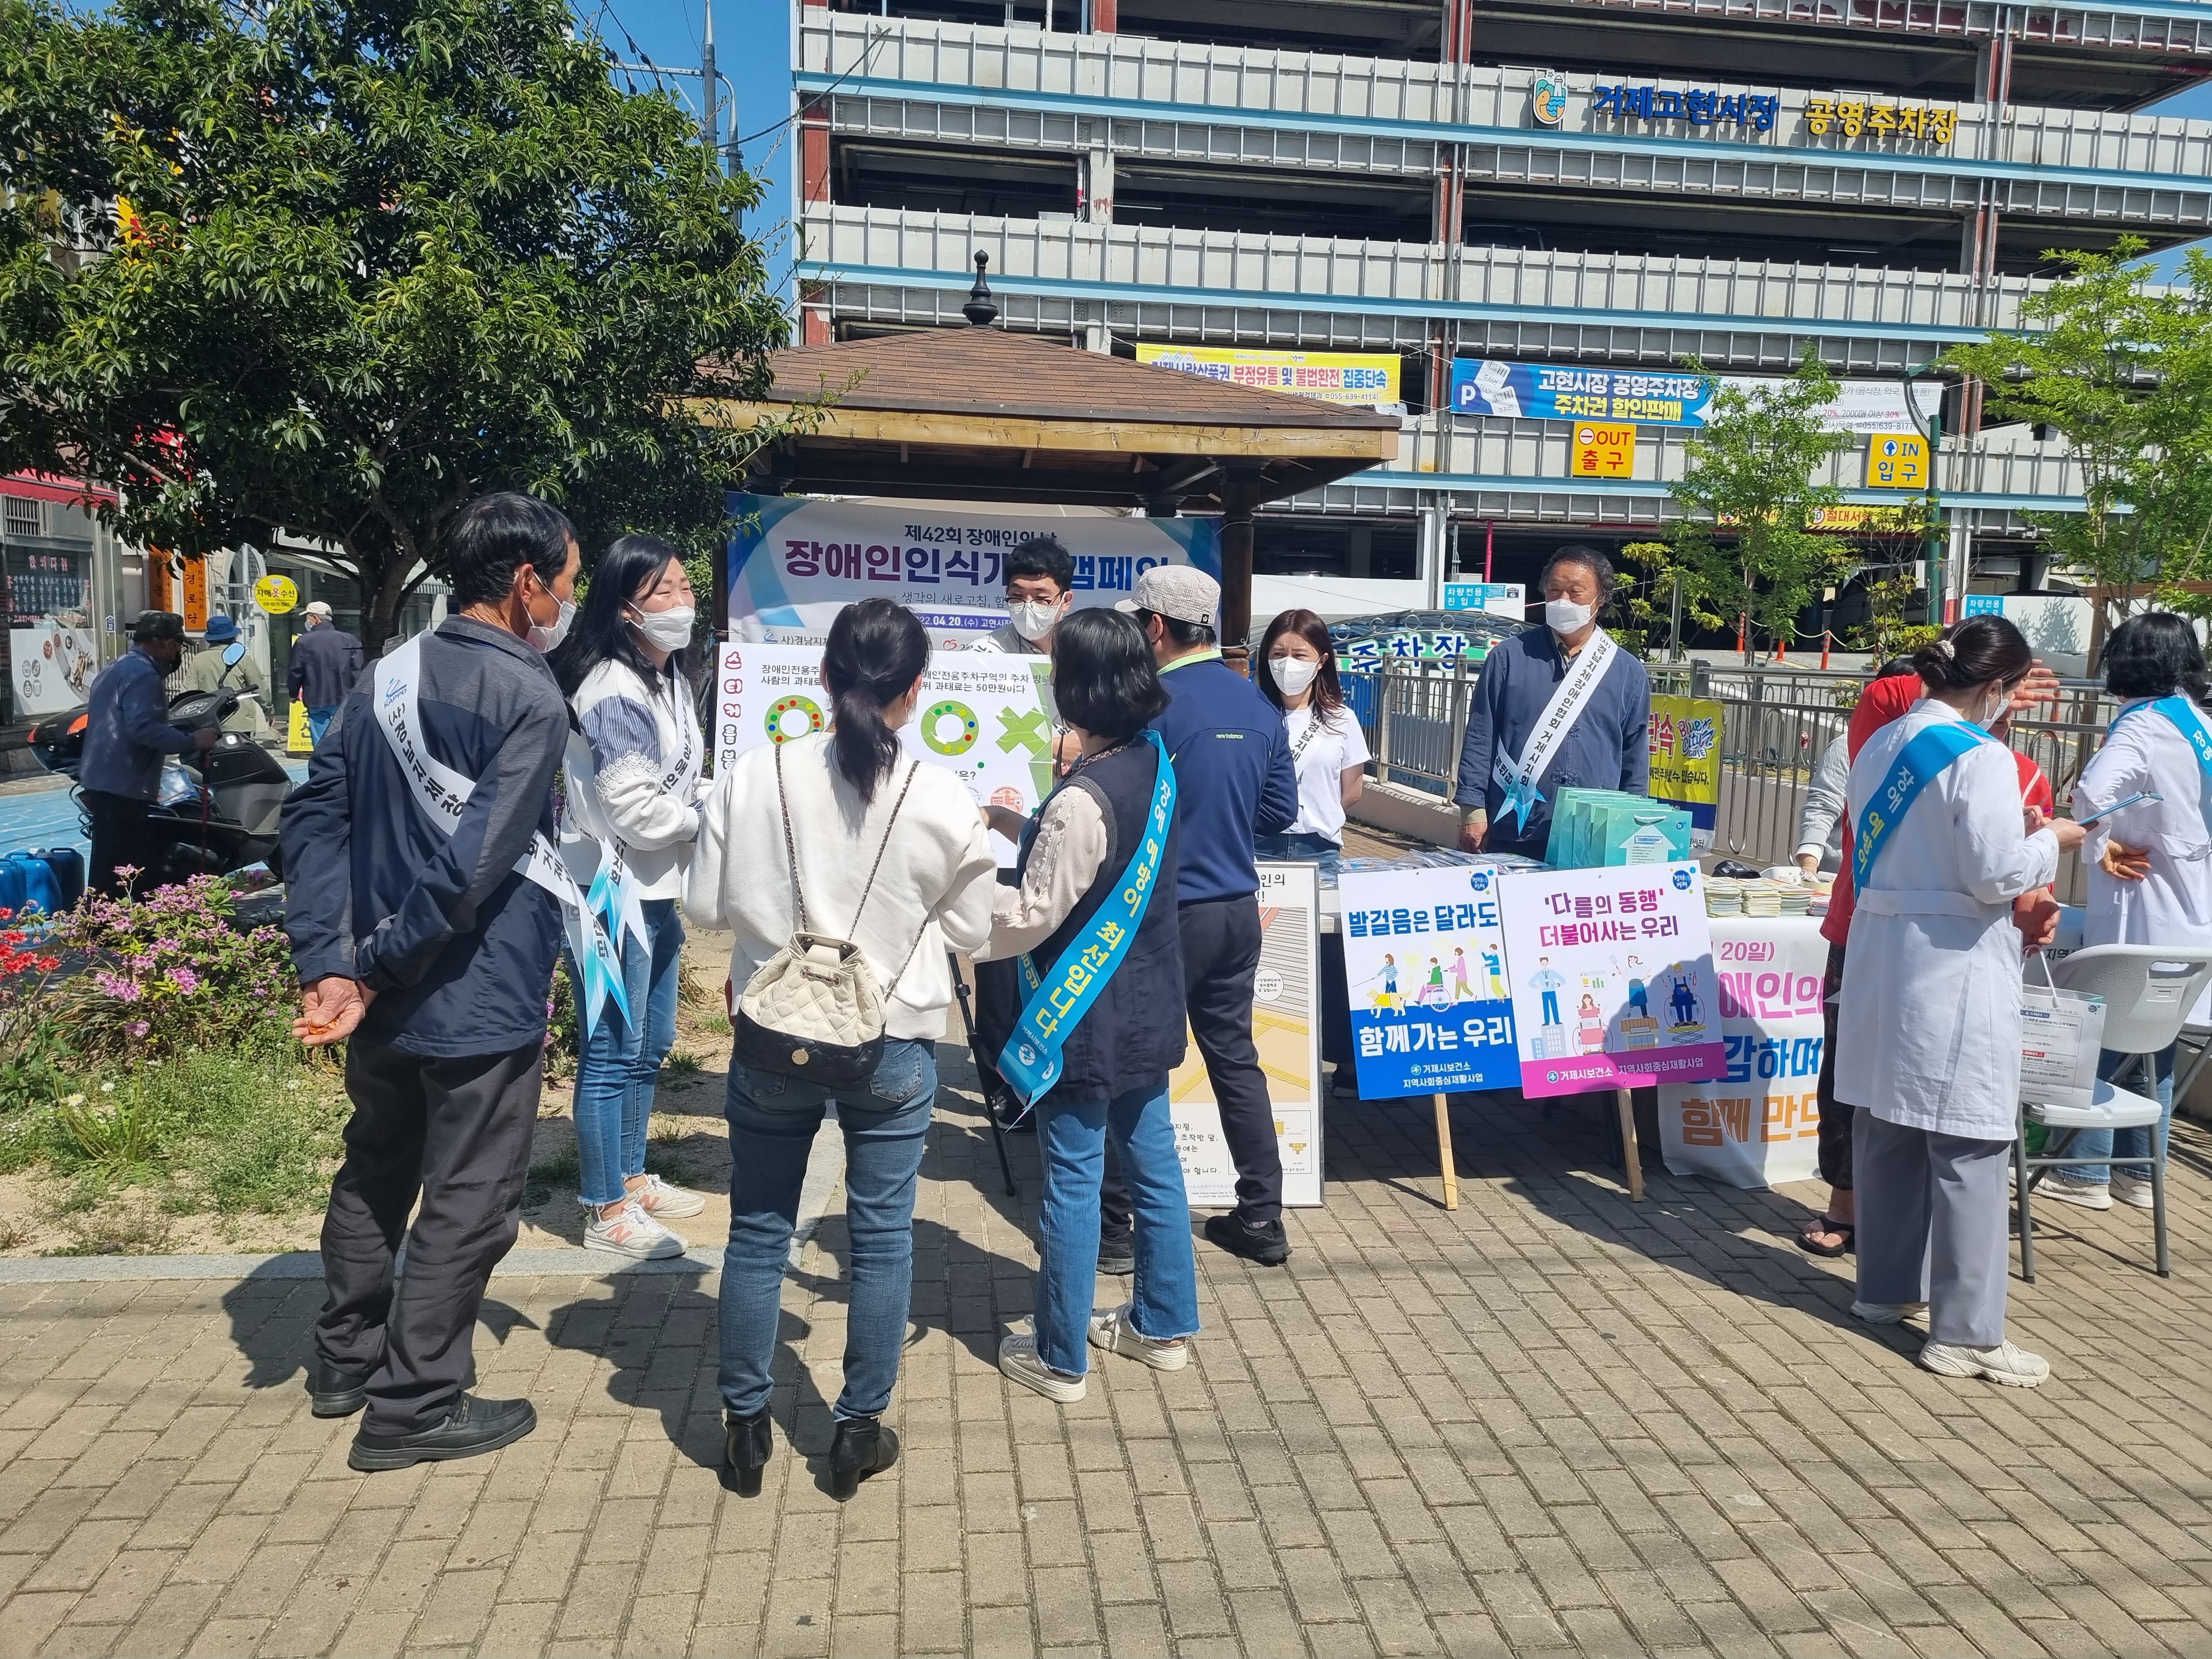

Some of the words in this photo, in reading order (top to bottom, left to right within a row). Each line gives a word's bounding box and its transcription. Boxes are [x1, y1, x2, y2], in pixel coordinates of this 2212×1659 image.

[1594, 86, 1780, 132] 거제고현시장
[1805, 99, 1959, 144] 공영주차장
[1234, 365, 1278, 385] 부정유통
[1282, 367, 1293, 386] 및
[1296, 368, 1340, 388] 불법환전
[1343, 369, 1386, 389] 집중단속
[1538, 370, 1610, 394] 고현시장
[1613, 375, 1700, 400] 공영주차장
[1461, 385, 1476, 405] P
[1884, 387, 1900, 396] 약국,
[1554, 394, 1607, 417] 주차권
[1612, 397, 1683, 421] 할인판매
[1842, 410, 1866, 418] 2000매
[1868, 410, 1884, 419] 이상
[1596, 431, 1631, 446] OUT
[1901, 443, 1919, 458] IN
[904, 524, 961, 544] 제42회
[901, 591, 936, 606] 생각의
[941, 594, 991, 609] 새로고침,
[1447, 588, 1482, 596] 차량전용
[1970, 600, 2000, 608] 차량전용
[761, 664, 820, 675] 장애인전용주
[1010, 673, 1029, 683] 주차
[761, 676, 789, 686] 사람의
[935, 682, 972, 692] 과태료는
[384, 688, 407, 708] KAPPD
[1519, 730, 1553, 787] 거제시지회
[1681, 770, 1709, 785] 있습니다.
[1887, 766, 1915, 814] 장애
[1154, 778, 1172, 834] 장애
[1124, 838, 1159, 918] 예방이
[1348, 908, 1430, 938] 발걸음은
[1434, 902, 1499, 932] 달라도
[1539, 921, 1637, 947] 더불어사는
[1641, 915, 1679, 939] 우리
[1720, 941, 1775, 962] 20일)
[1035, 921, 1126, 1040] 최선입니다
[1719, 972, 1824, 1019] 애인의
[1021, 1025, 1048, 1056] 거제시보건소
[1359, 1023, 1458, 1057] 함께가는
[1463, 1016, 1513, 1047] 우리
[1423, 1062, 1471, 1074] 거제시보건소
[1560, 1066, 1613, 1081] 거제시보건소
[1618, 1057, 1703, 1075] 지역사회중심재활사업
[1723, 1035, 1824, 1084] 감하며
[1403, 1073, 1483, 1088] 지역사회중심재활사업
[1681, 1098, 1751, 1147] 함께
[1194, 1167, 1221, 1175] 합니다.
